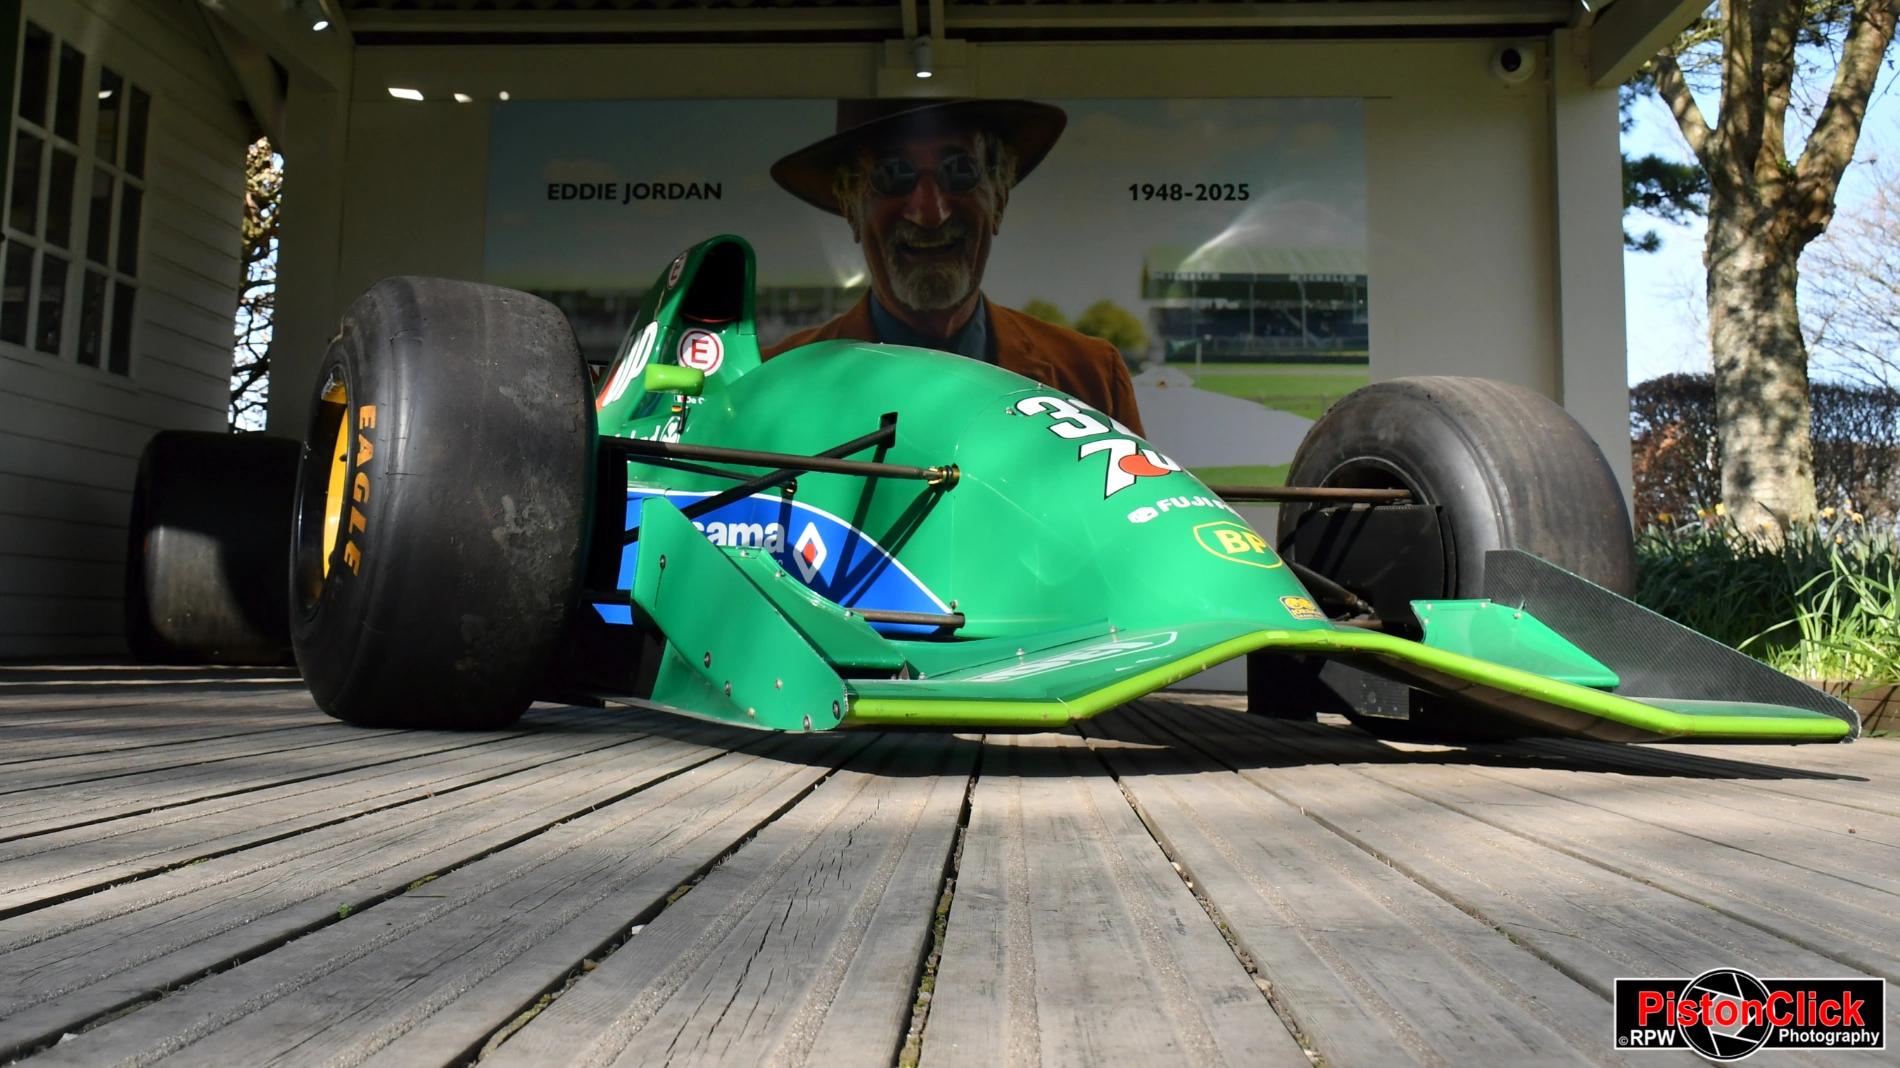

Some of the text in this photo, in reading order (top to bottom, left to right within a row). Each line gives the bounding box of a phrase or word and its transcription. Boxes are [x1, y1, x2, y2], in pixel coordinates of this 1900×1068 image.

[547, 183, 722, 205] EDDIE JORDAN
[1128, 183, 1250, 201] 1948-2025
[690, 338, 709, 365] E
[1078, 438, 1184, 500] 7U
[343, 405, 377, 577] EAGLE
[1156, 496, 1215, 512] FUJI
[1213, 529, 1267, 554] BP
